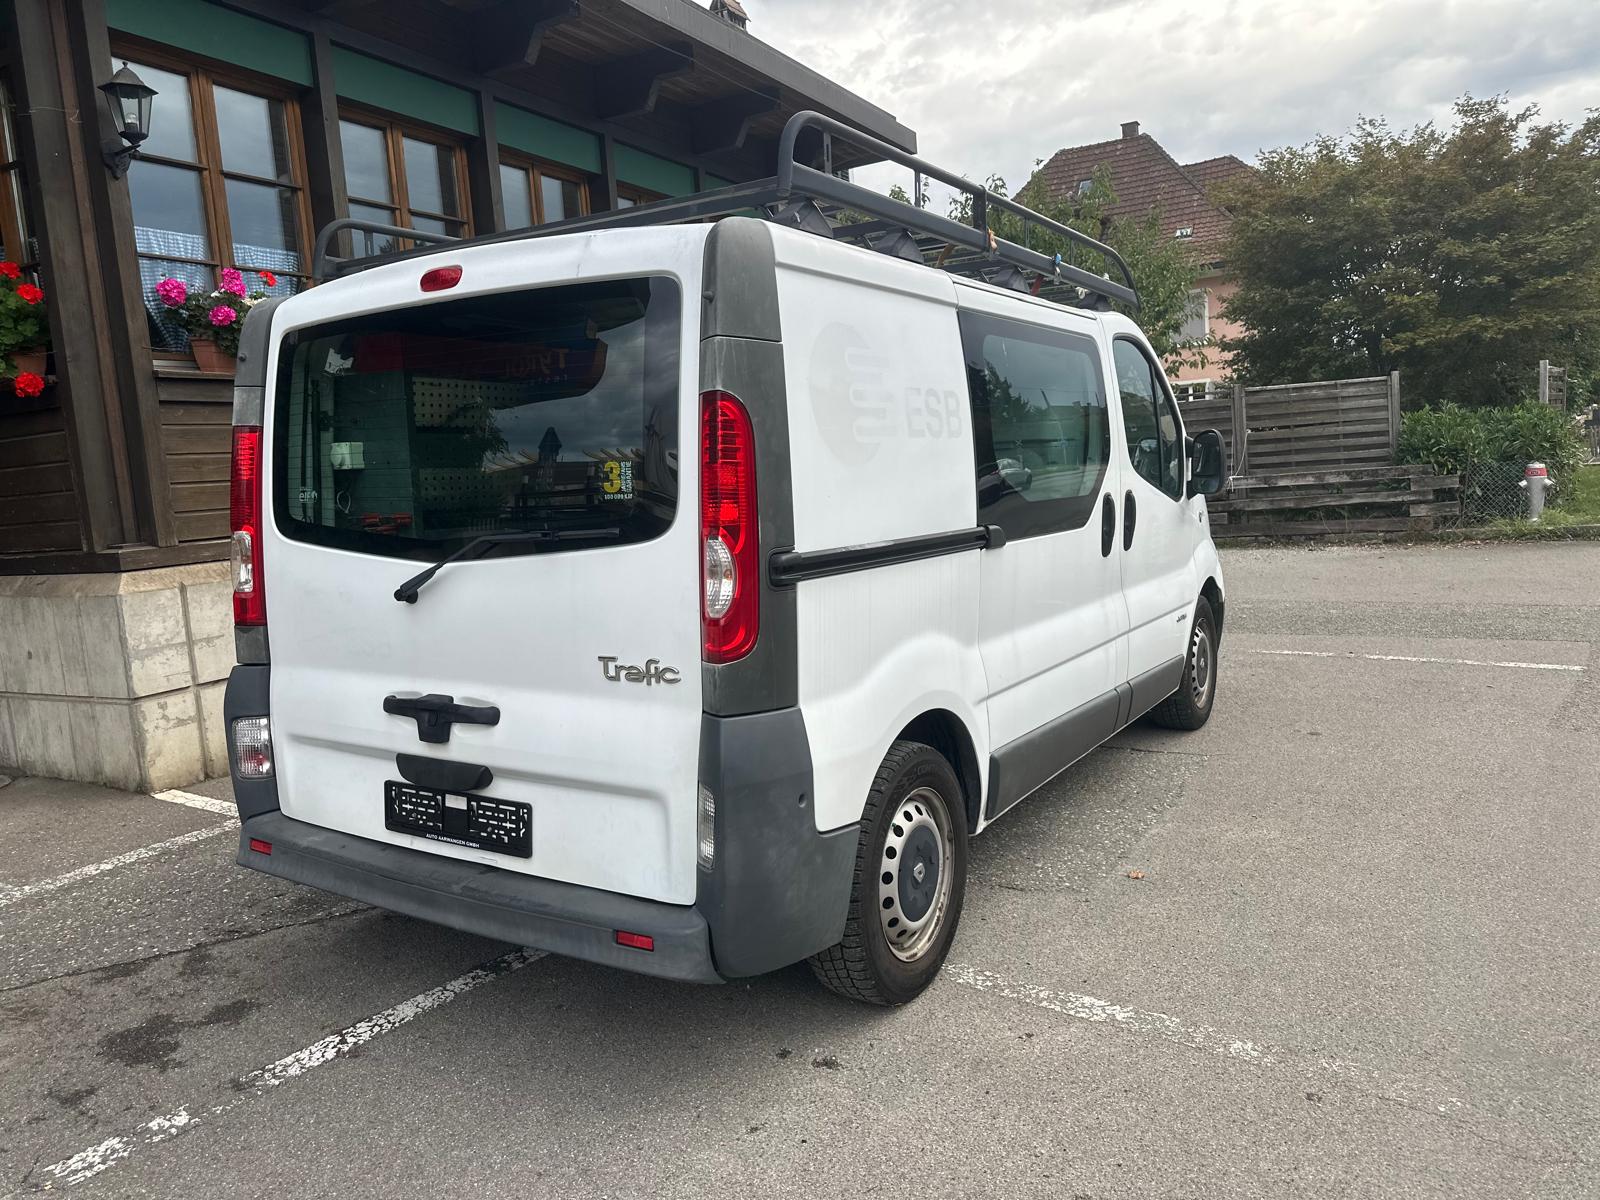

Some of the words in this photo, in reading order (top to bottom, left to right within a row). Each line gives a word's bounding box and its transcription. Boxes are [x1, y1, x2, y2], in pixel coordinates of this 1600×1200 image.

[904, 387, 962, 439] ESB
[603, 461, 621, 493] 3
[597, 656, 682, 686] Trafic
[438, 836, 466, 846] AARWANGEN
